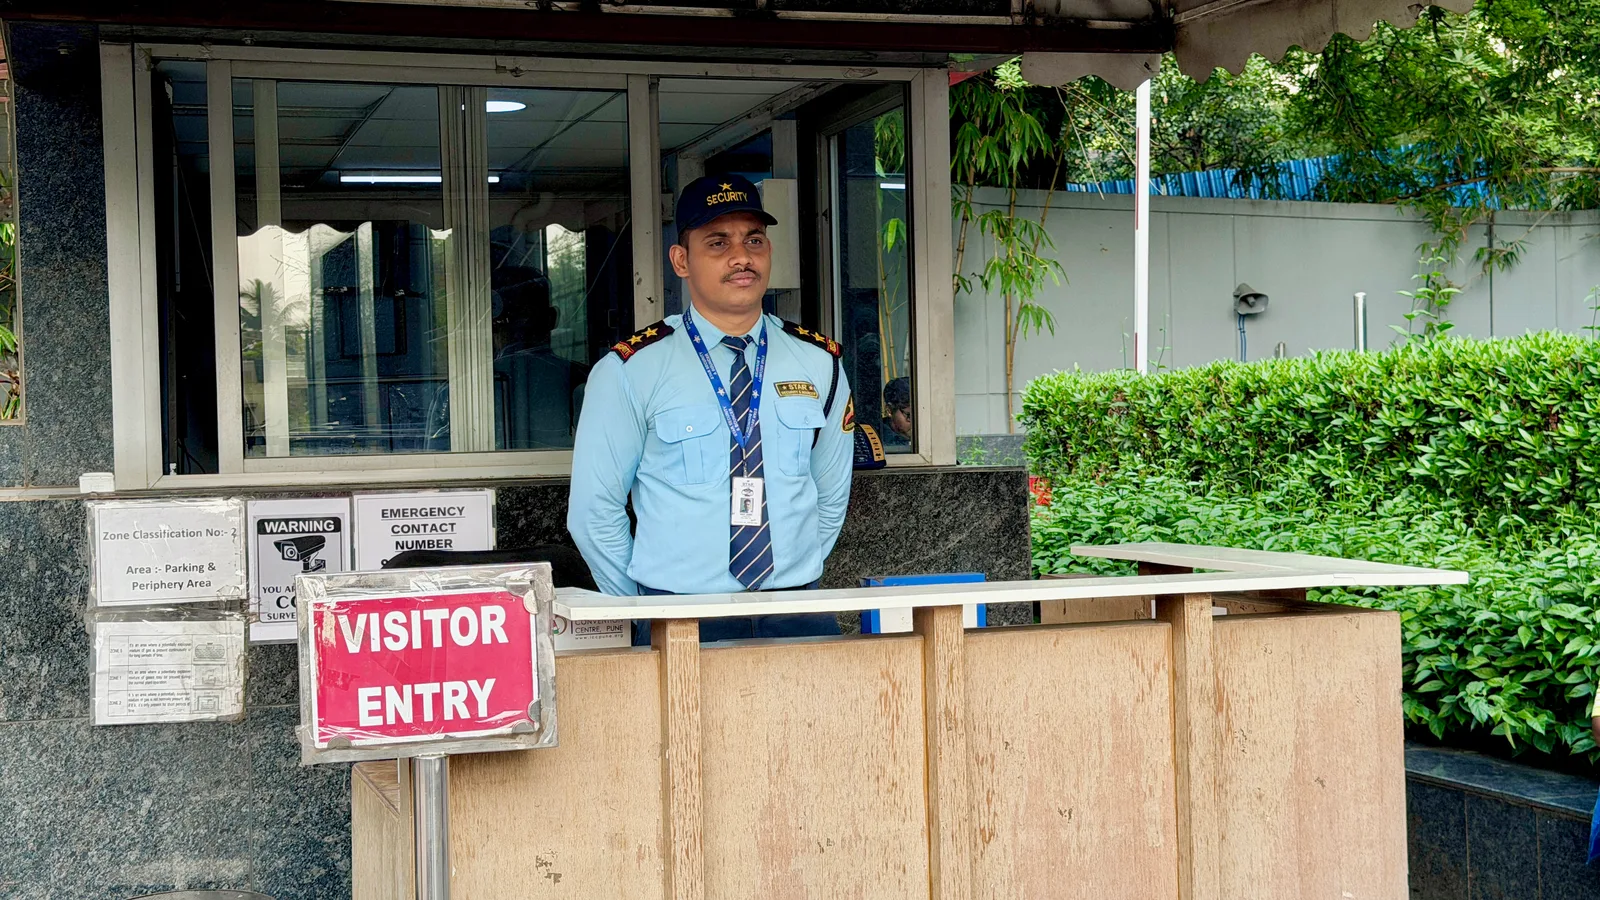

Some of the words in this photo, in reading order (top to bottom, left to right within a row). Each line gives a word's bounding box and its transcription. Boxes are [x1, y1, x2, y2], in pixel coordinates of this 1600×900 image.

[706, 192, 748, 206] SECURITY
[723, 406, 733, 426] SECURITY
[381, 506, 465, 518] EMERGENCY
[264, 520, 335, 533] WARNING
[391, 522, 456, 534] CONTACT
[103, 531, 130, 540] Zone
[133, 528, 202, 539] Classification
[206, 528, 228, 537] No:-
[395, 538, 453, 550] NUMBER
[126, 566, 152, 574] Area
[165, 562, 204, 573] Parking
[208, 562, 216, 571] &
[132, 580, 184, 591] Periphery
[186, 579, 212, 588] Area
[338, 605, 508, 654] VISITOR
[358, 678, 496, 726] ENTRY
